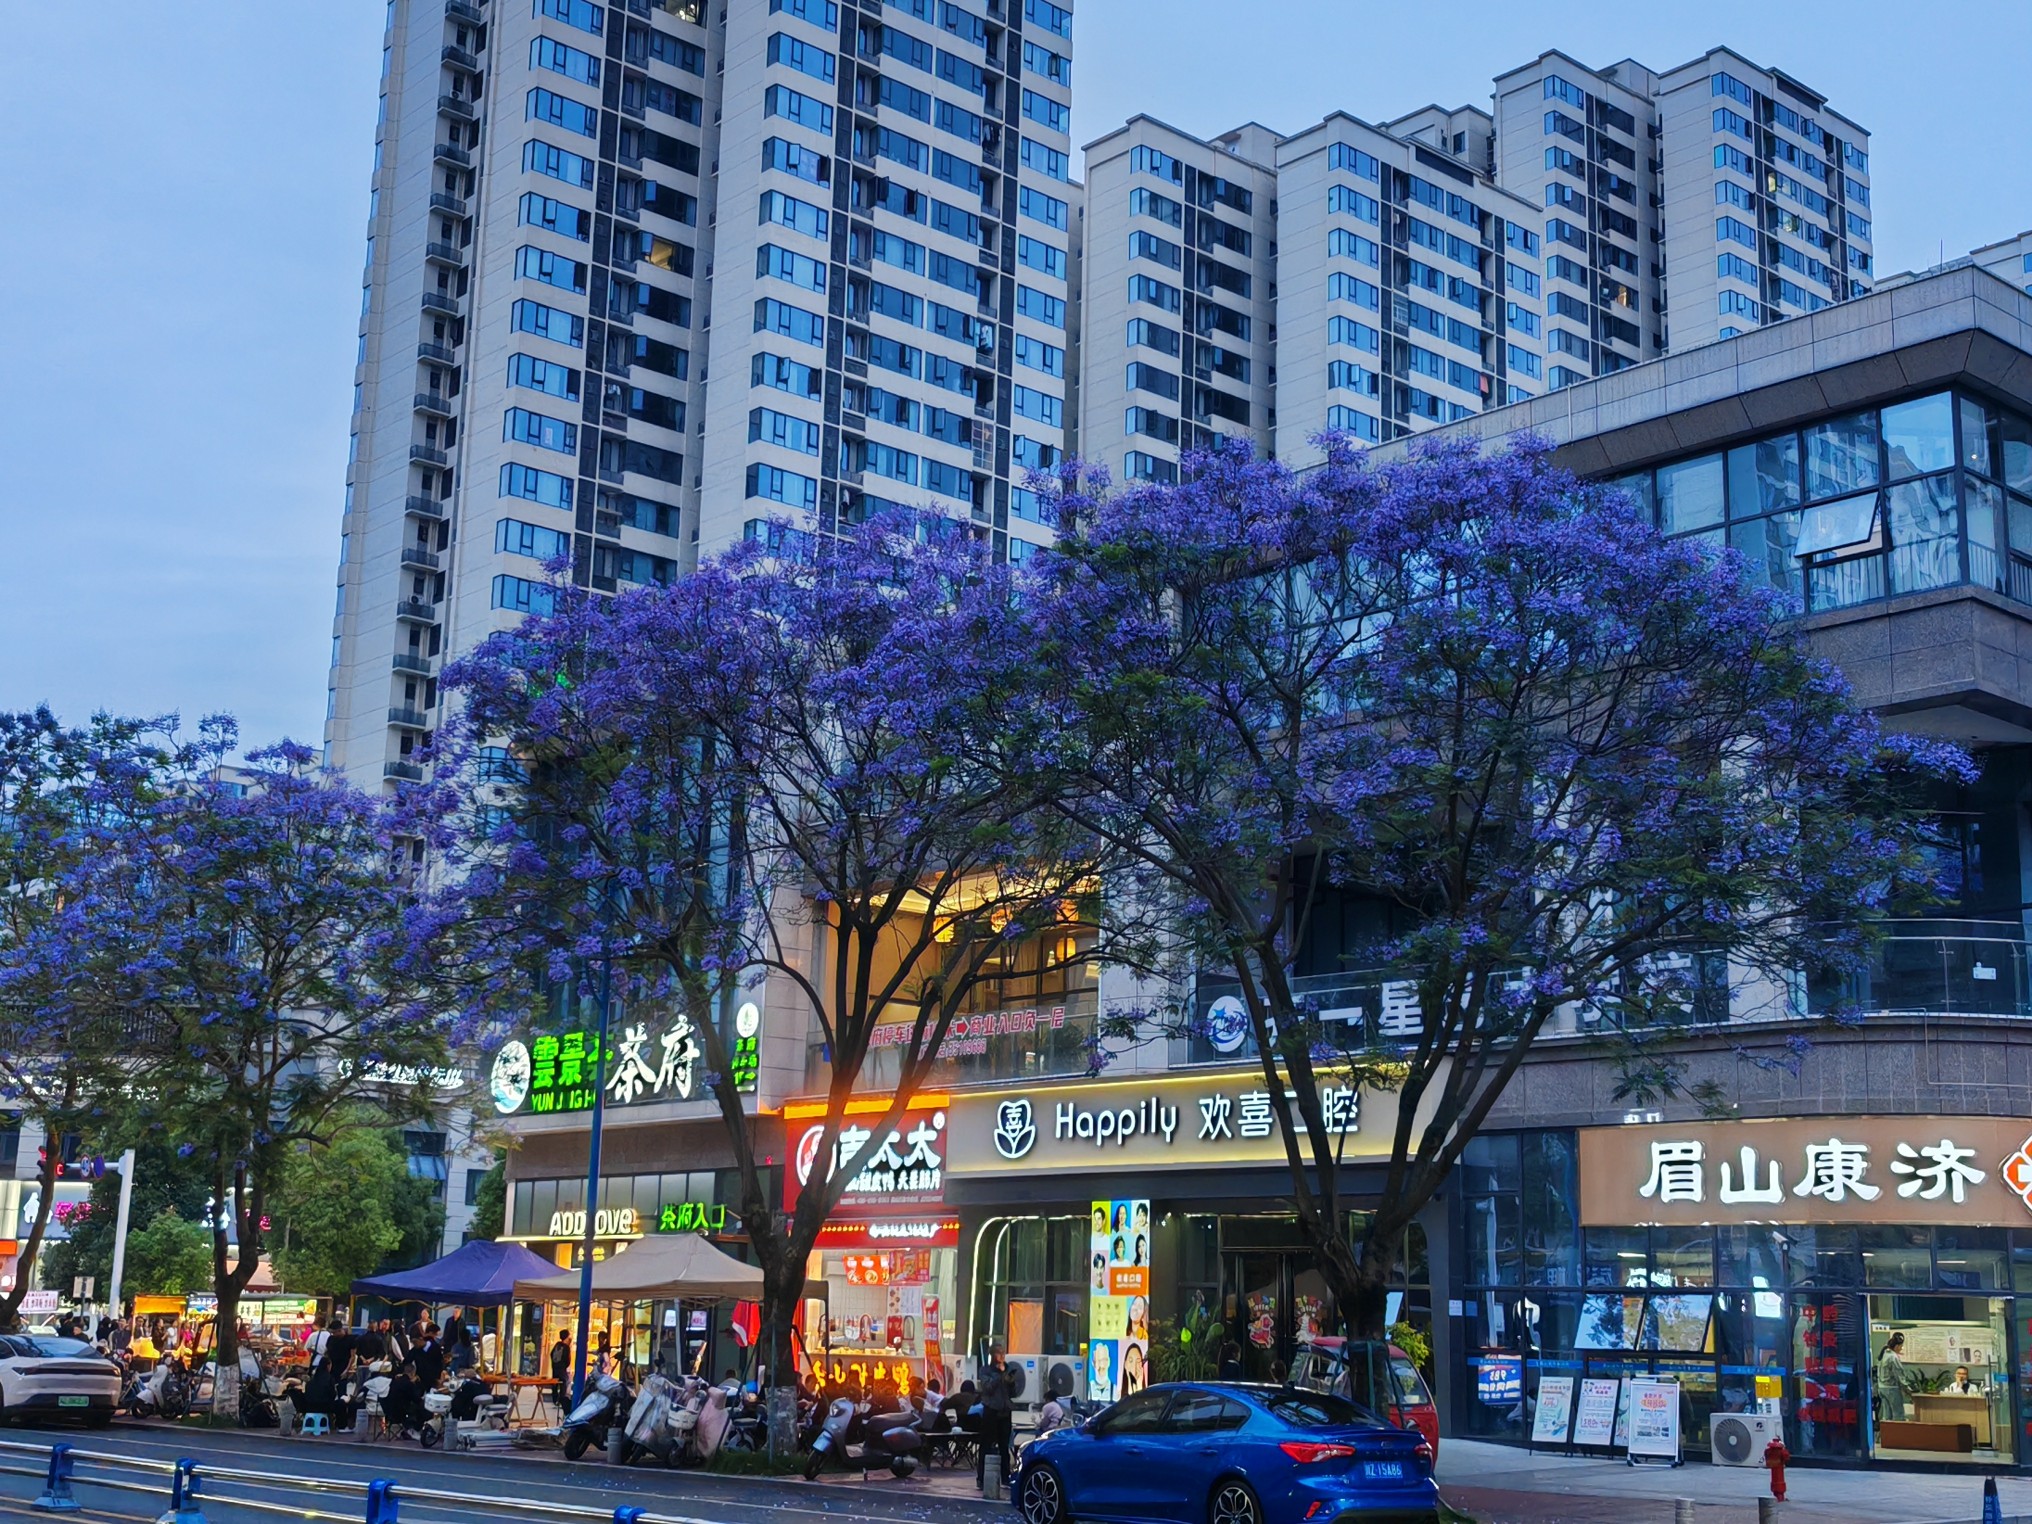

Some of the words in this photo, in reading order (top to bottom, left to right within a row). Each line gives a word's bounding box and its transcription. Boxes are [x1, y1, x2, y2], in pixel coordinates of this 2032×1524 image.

[605, 1014, 700, 1104] 茶府
[1055, 1096, 1179, 1147] Happily
[1639, 1137, 1986, 1205] 眉山康济
[660, 1202, 727, 1231] 茶府入口
